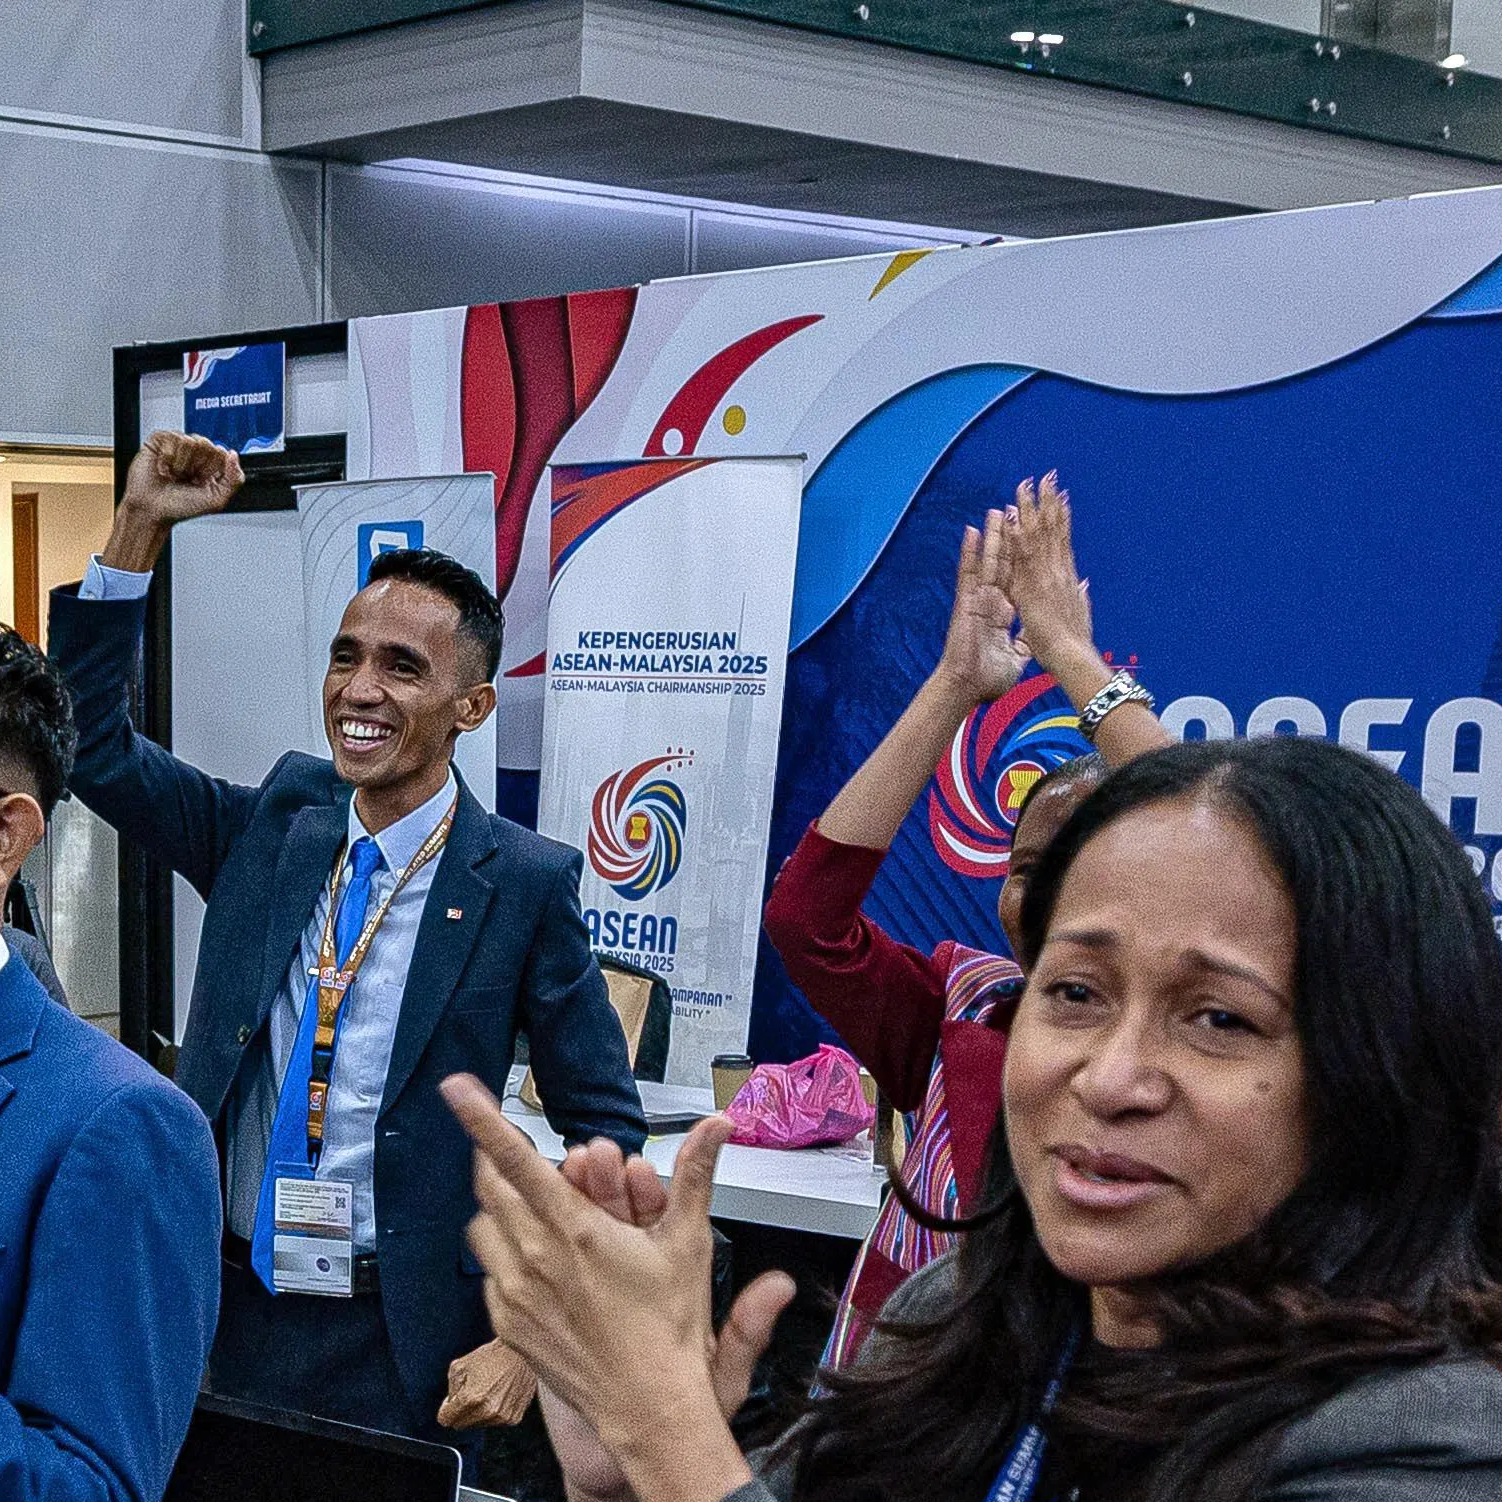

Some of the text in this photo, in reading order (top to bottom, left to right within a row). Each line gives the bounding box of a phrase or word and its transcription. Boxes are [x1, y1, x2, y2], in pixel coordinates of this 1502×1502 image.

[220, 391, 271, 408] SECRETARIAT
[577, 631, 737, 651] KEPENGERUSIAN
[551, 653, 768, 675] ASEAN-MALAYSIA 2025
[550, 680, 766, 696] ASEAN-MALAYSIA CHAIRMANSHIP 2025
[582, 908, 678, 954] ASEAN
[644, 954, 675, 973] 2025
